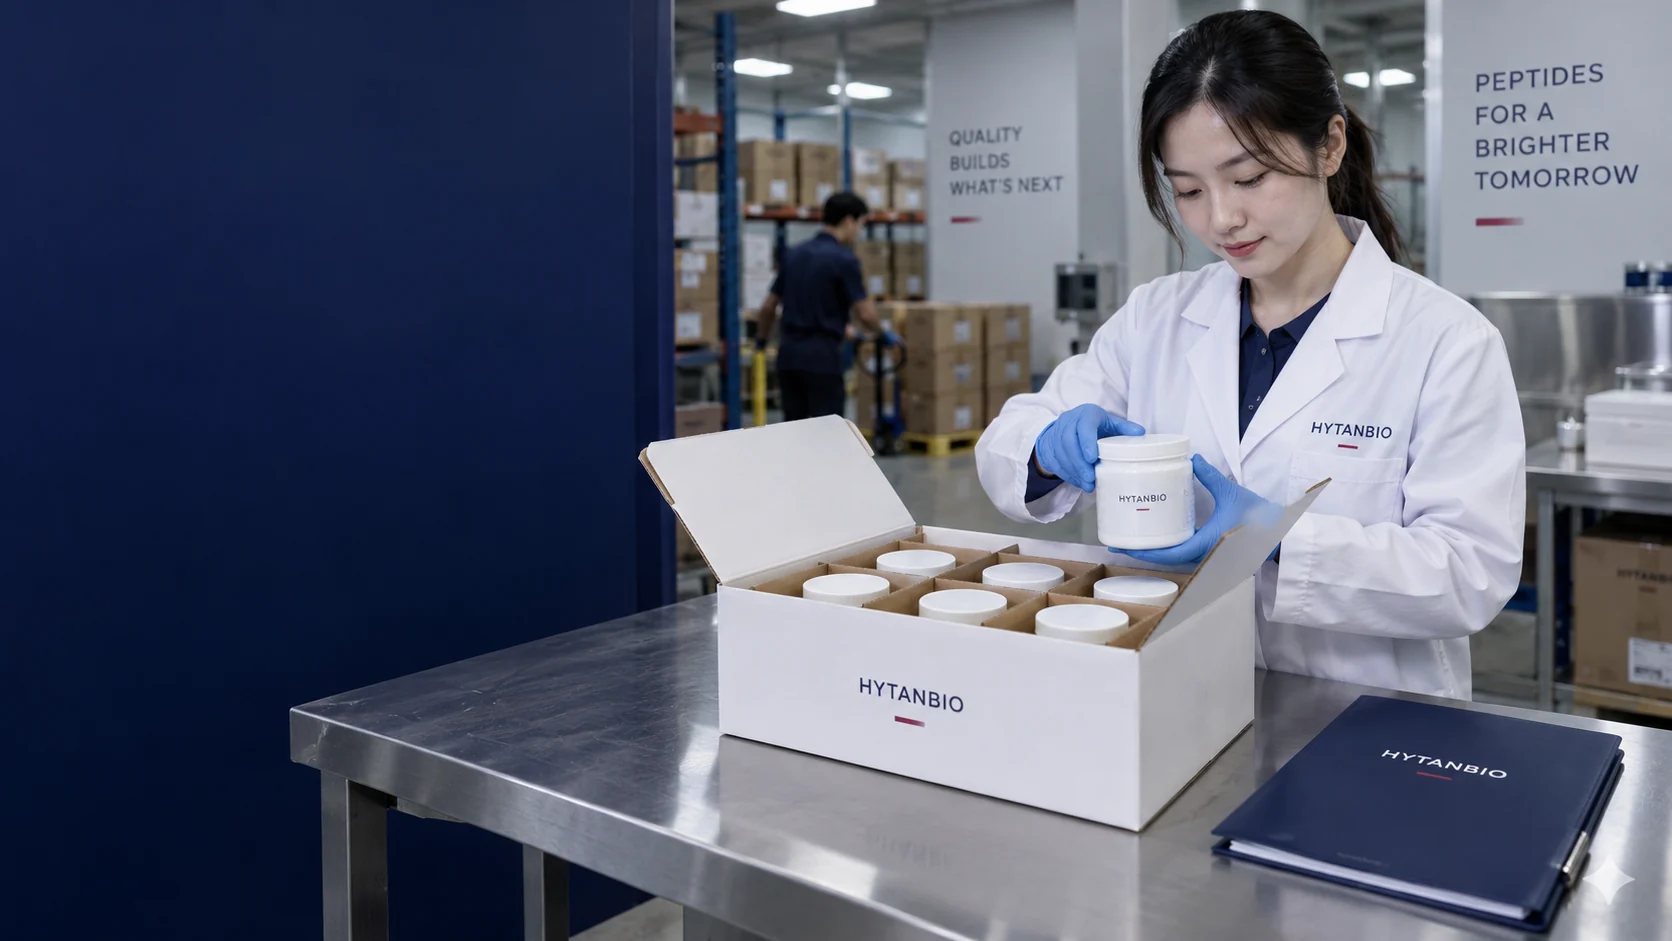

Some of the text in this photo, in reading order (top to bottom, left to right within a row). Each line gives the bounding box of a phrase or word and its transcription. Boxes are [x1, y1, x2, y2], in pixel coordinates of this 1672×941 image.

[1476, 64, 1604, 92] PEPTIDES
[1475, 102, 1554, 125] FOR A
[950, 127, 1022, 147] QUALITY
[1475, 131, 1610, 158] BRIGHTER
[950, 153, 1010, 171] BUILDS
[950, 175, 1064, 196] WHAT'S NEXT
[1475, 164, 1639, 190] TOMORROW
[1311, 421, 1393, 439] HYTANBIO
[1118, 493, 1167, 503] HYTANBIO
[859, 677, 964, 713] HYTANBIO
[1381, 749, 1508, 780] HYTANBIO
